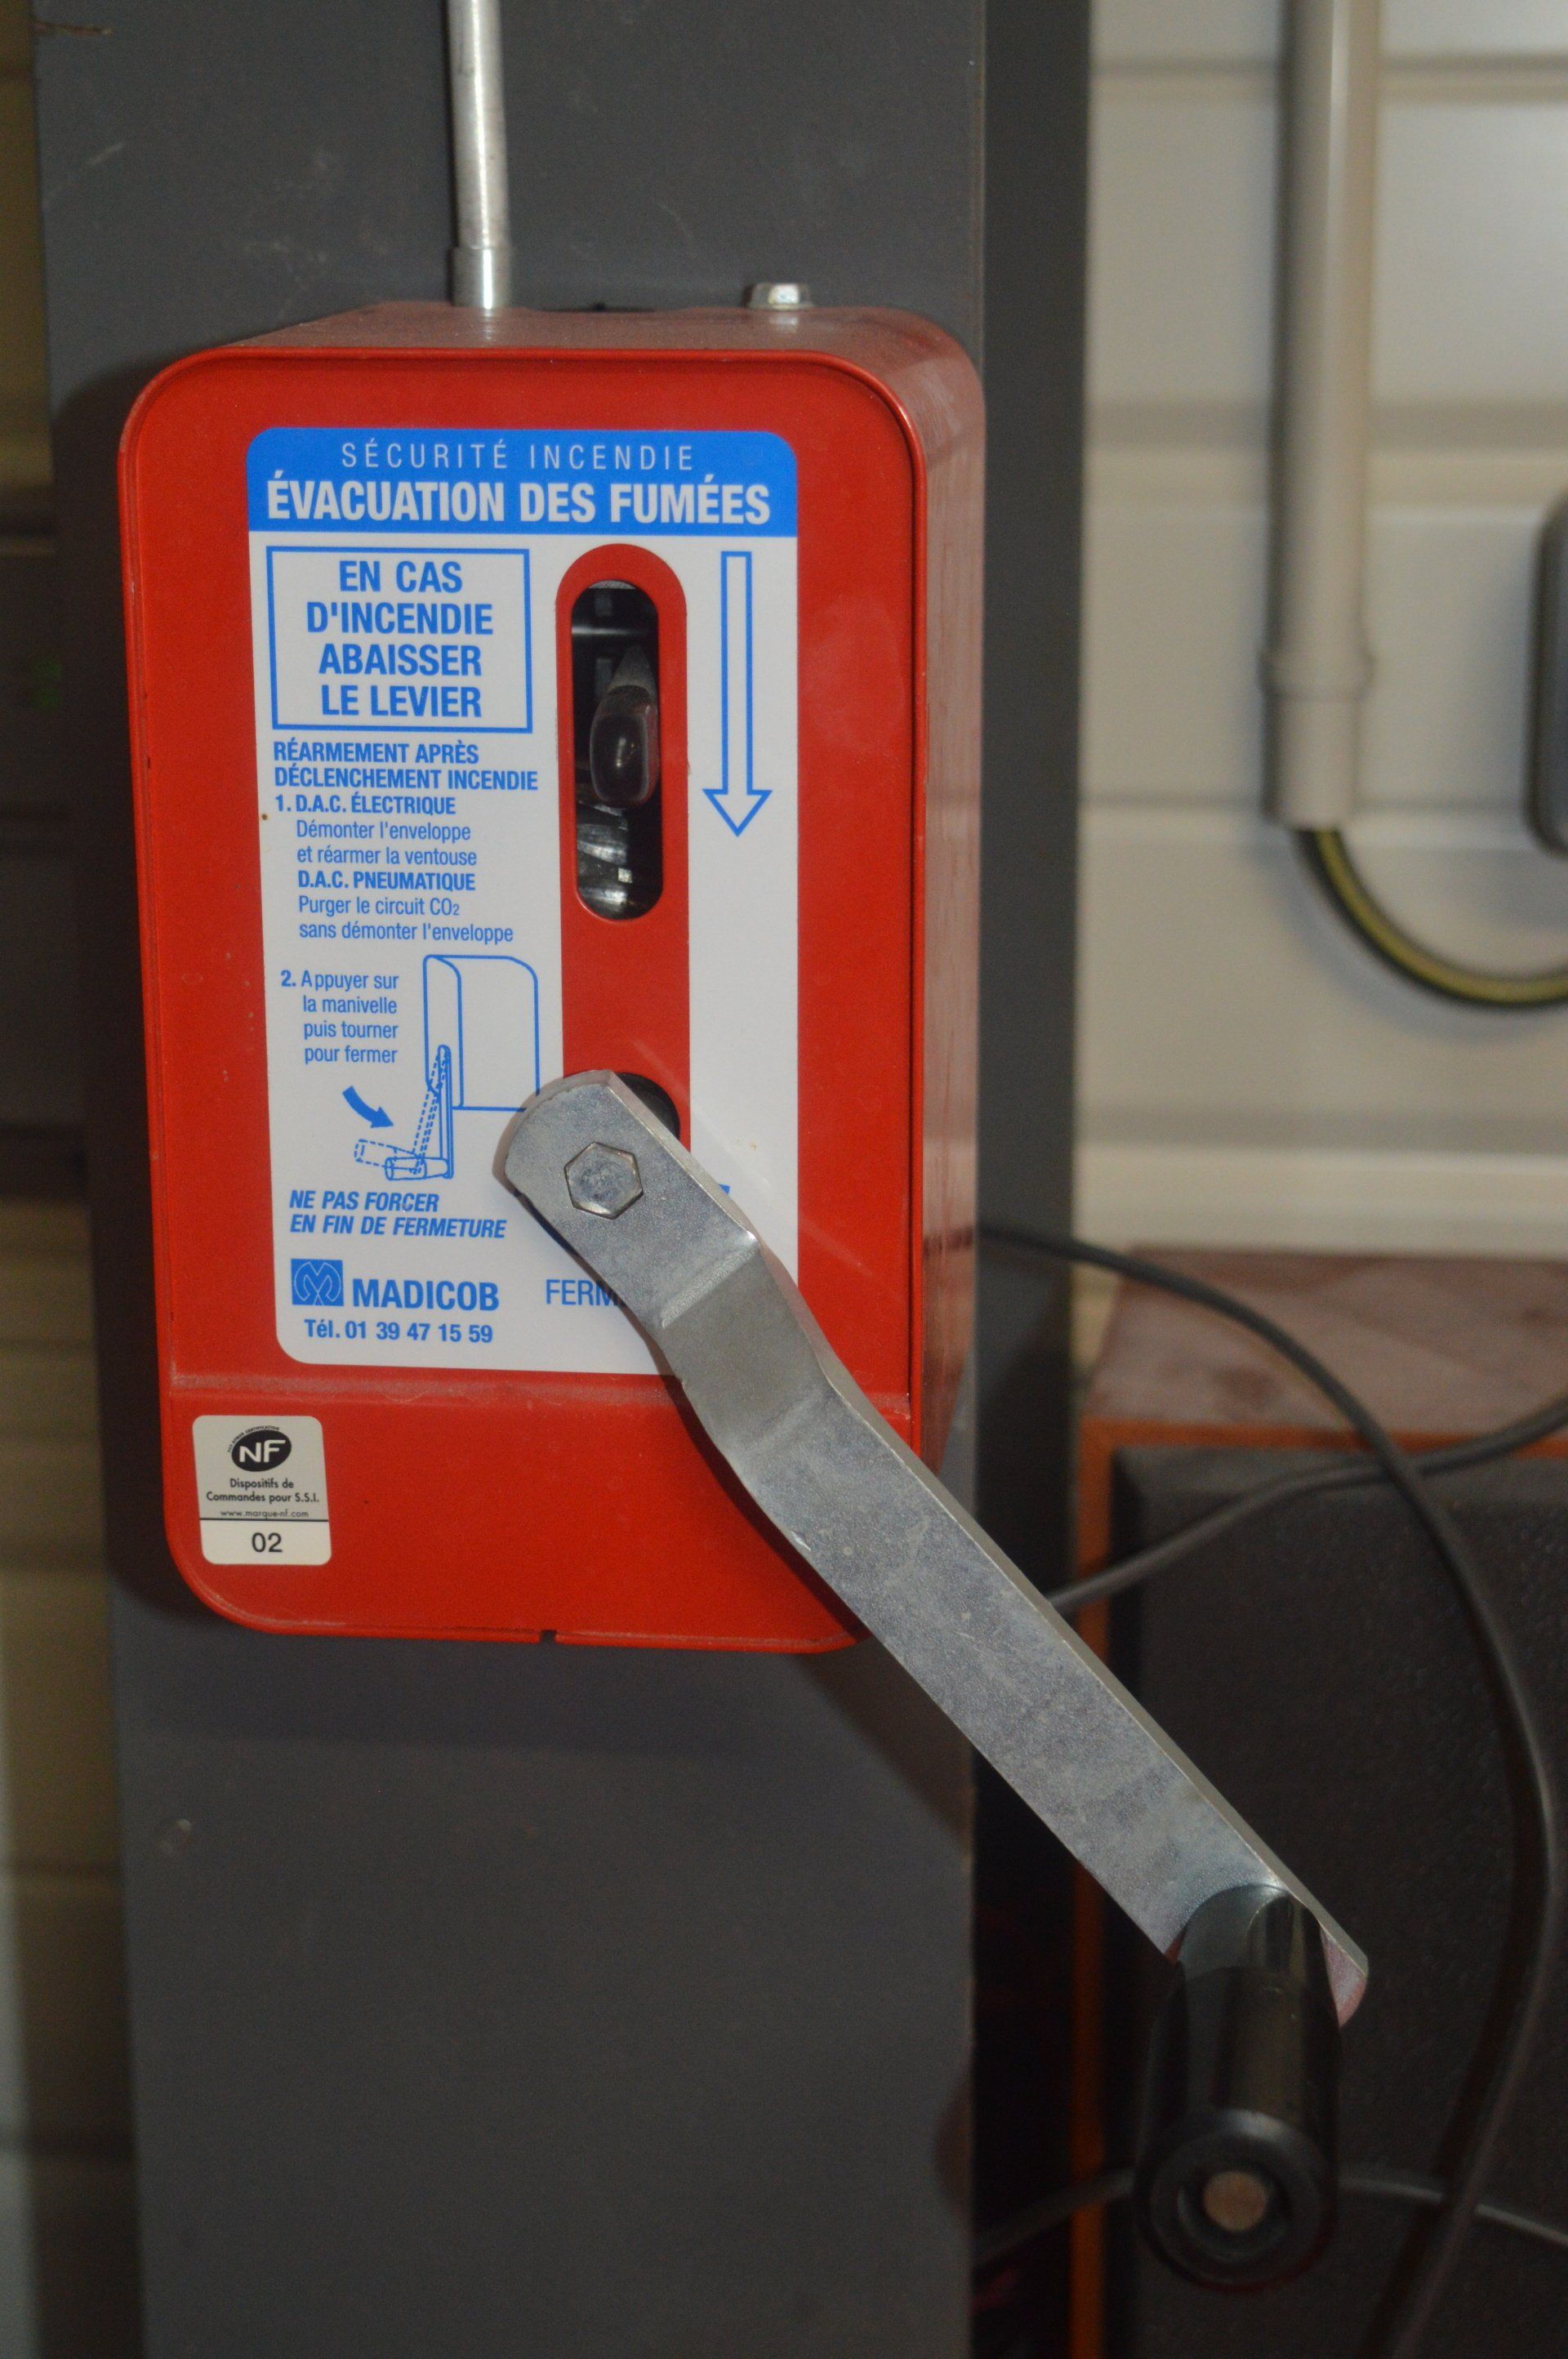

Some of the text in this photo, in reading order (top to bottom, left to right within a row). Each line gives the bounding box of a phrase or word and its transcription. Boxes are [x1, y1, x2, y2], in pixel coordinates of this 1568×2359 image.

[342, 438, 692, 470] SÉCURITÉ INCENDIE
[267, 470, 770, 524] ÉVACUATION DES FUMÉES
[340, 560, 462, 593] EN CAS
[306, 602, 492, 635] D'INCENDIE
[318, 644, 481, 676] ABAISSER
[321, 685, 481, 718] LE LEVIER
[274, 738, 479, 765] RÉARMEMENT APRÈS
[274, 763, 537, 791] DÉCLENCHEMENT INCENDIE
[274, 792, 456, 815] 1. D.A.C. ÉLECTRIQUE
[296, 819, 471, 844] Démonter l'enveloppe
[296, 845, 477, 866] et réarmer la ventouse
[297, 870, 474, 891] D.A.C. PNEUMATIQUE
[297, 895, 352, 917] Purger
[355, 897, 371, 915] le
[374, 899, 425, 916] circuit
[299, 921, 514, 945] sans démonter l'enveloppe
[280, 970, 399, 992] 2. Appuyer sur
[302, 996, 398, 1015] la manivelle
[303, 1016, 399, 1041] puis tourner
[304, 1046, 398, 1064] pour fermer
[289, 1190, 439, 1212] NE PAS FORCER
[291, 1214, 506, 1239] EN FIN DE FERMETURE
[352, 1278, 500, 1311] MADICOB
[546, 1278, 627, 1307] FERM
[303, 1318, 493, 1344] Tél. 01 39 47 15 59
[238, 1439, 286, 1463] NF
[230, 1478, 294, 1490] Dispositifs de
[207, 1492, 318, 1504] Commandes pour S.S.I.
[220, 1509, 309, 1519] www.marque-nf.com
[252, 1532, 283, 1552] 02
